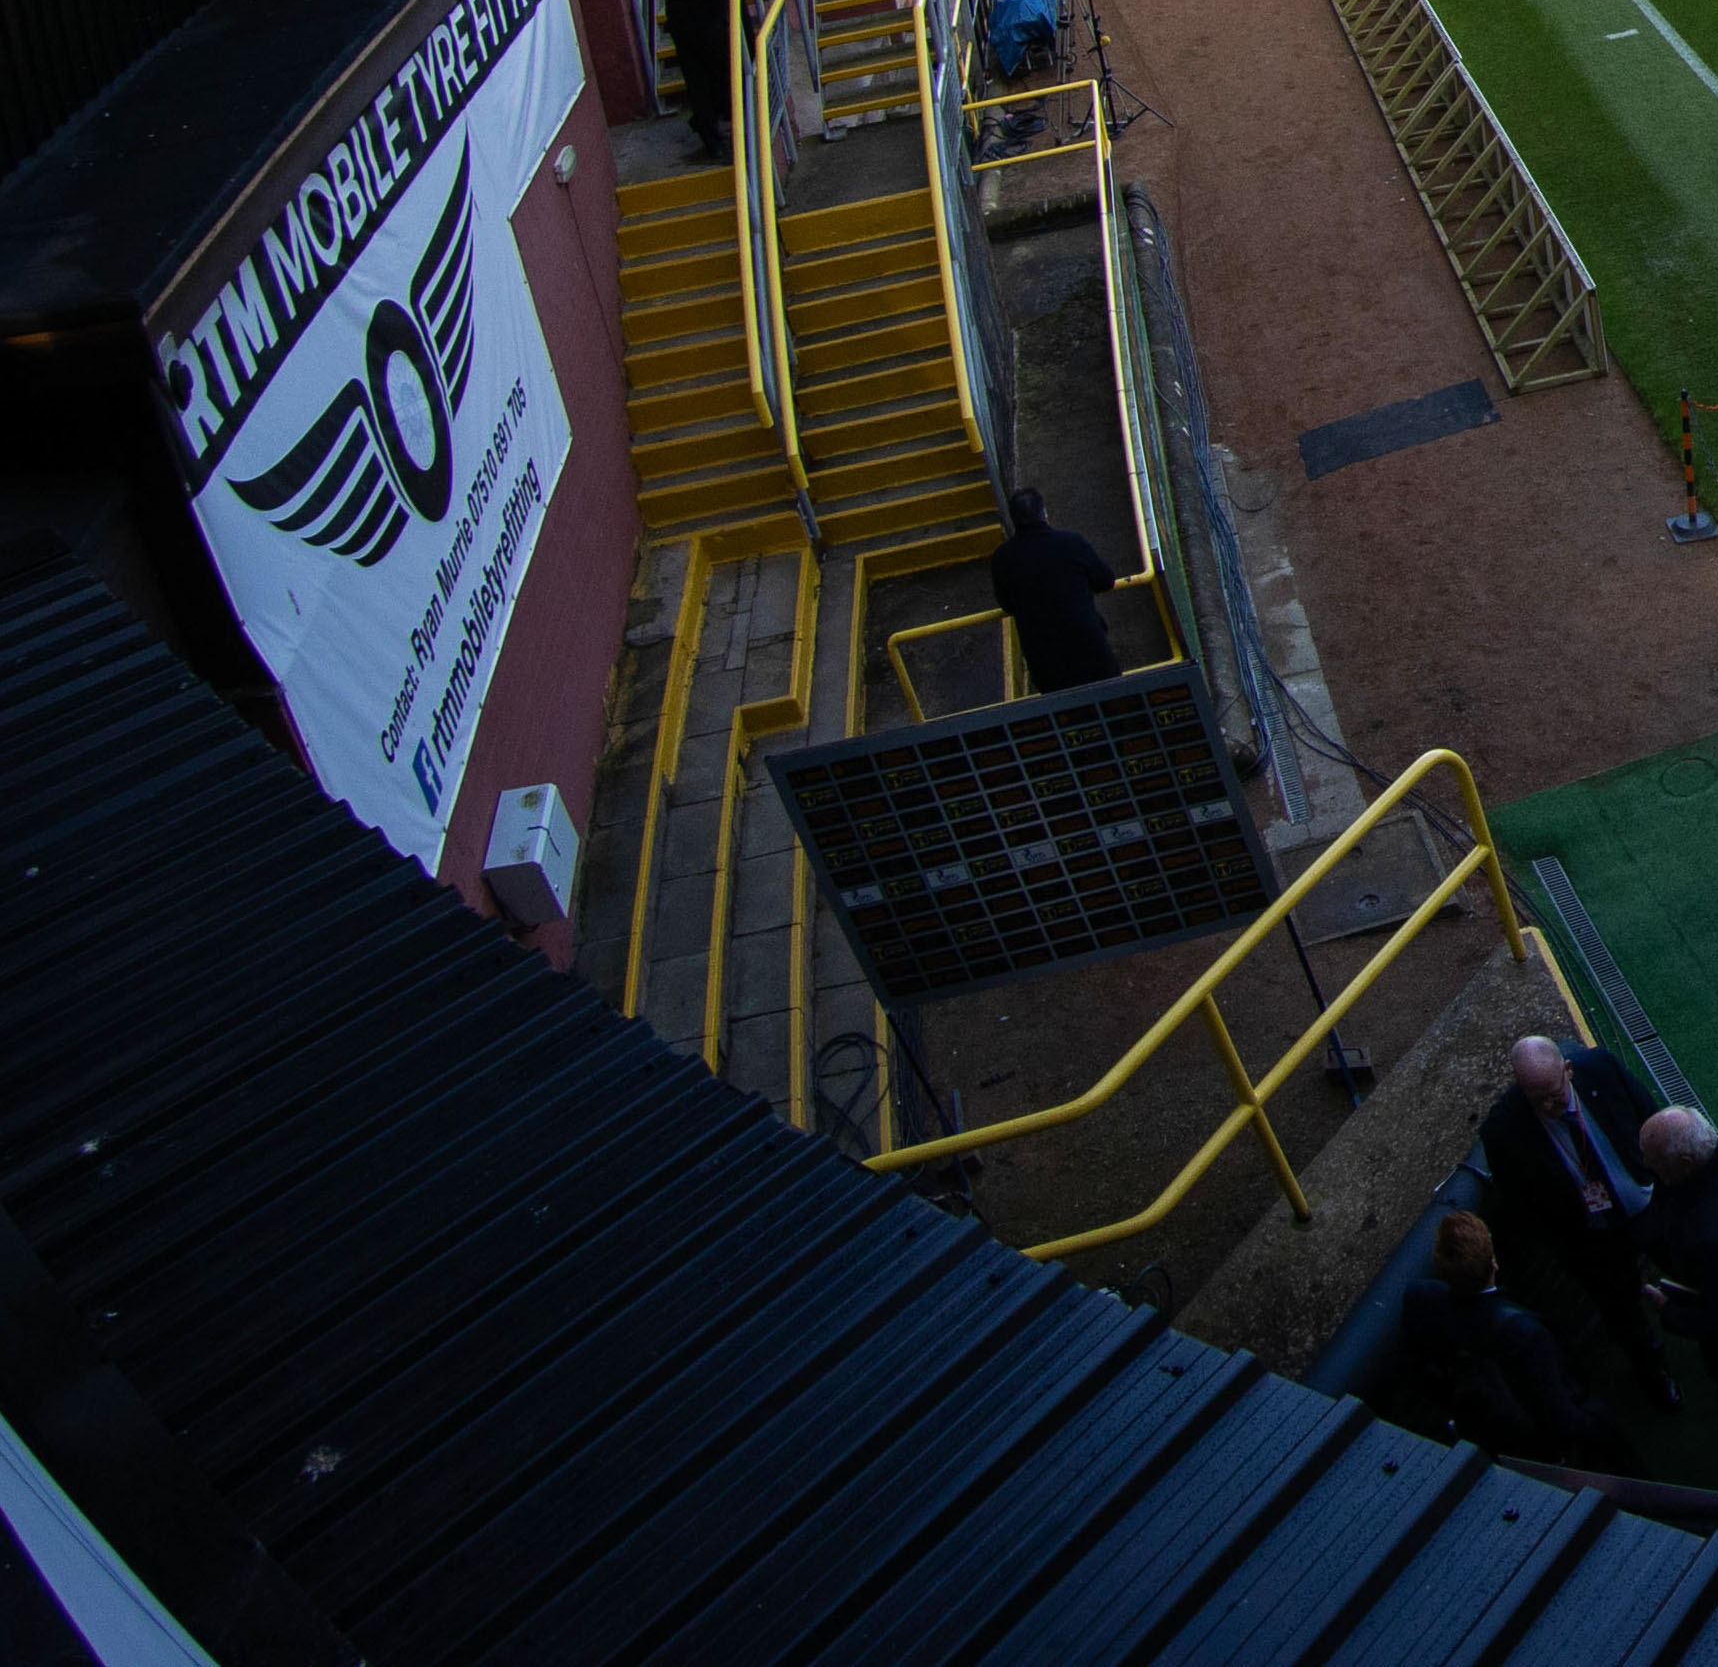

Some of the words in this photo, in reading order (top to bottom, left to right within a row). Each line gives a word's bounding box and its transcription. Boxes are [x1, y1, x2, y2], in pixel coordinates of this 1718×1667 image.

[262, 88, 412, 321] MOBILE
[380, 667, 421, 764] Contact:
[410, 591, 443, 670] Ryan
[435, 518, 473, 605] Murrie
[466, 447, 500, 528] 07510
[495, 416, 515, 470] 691
[506, 376, 527, 428] 705
[430, 456, 543, 770] rtmmobiletyrefitting
